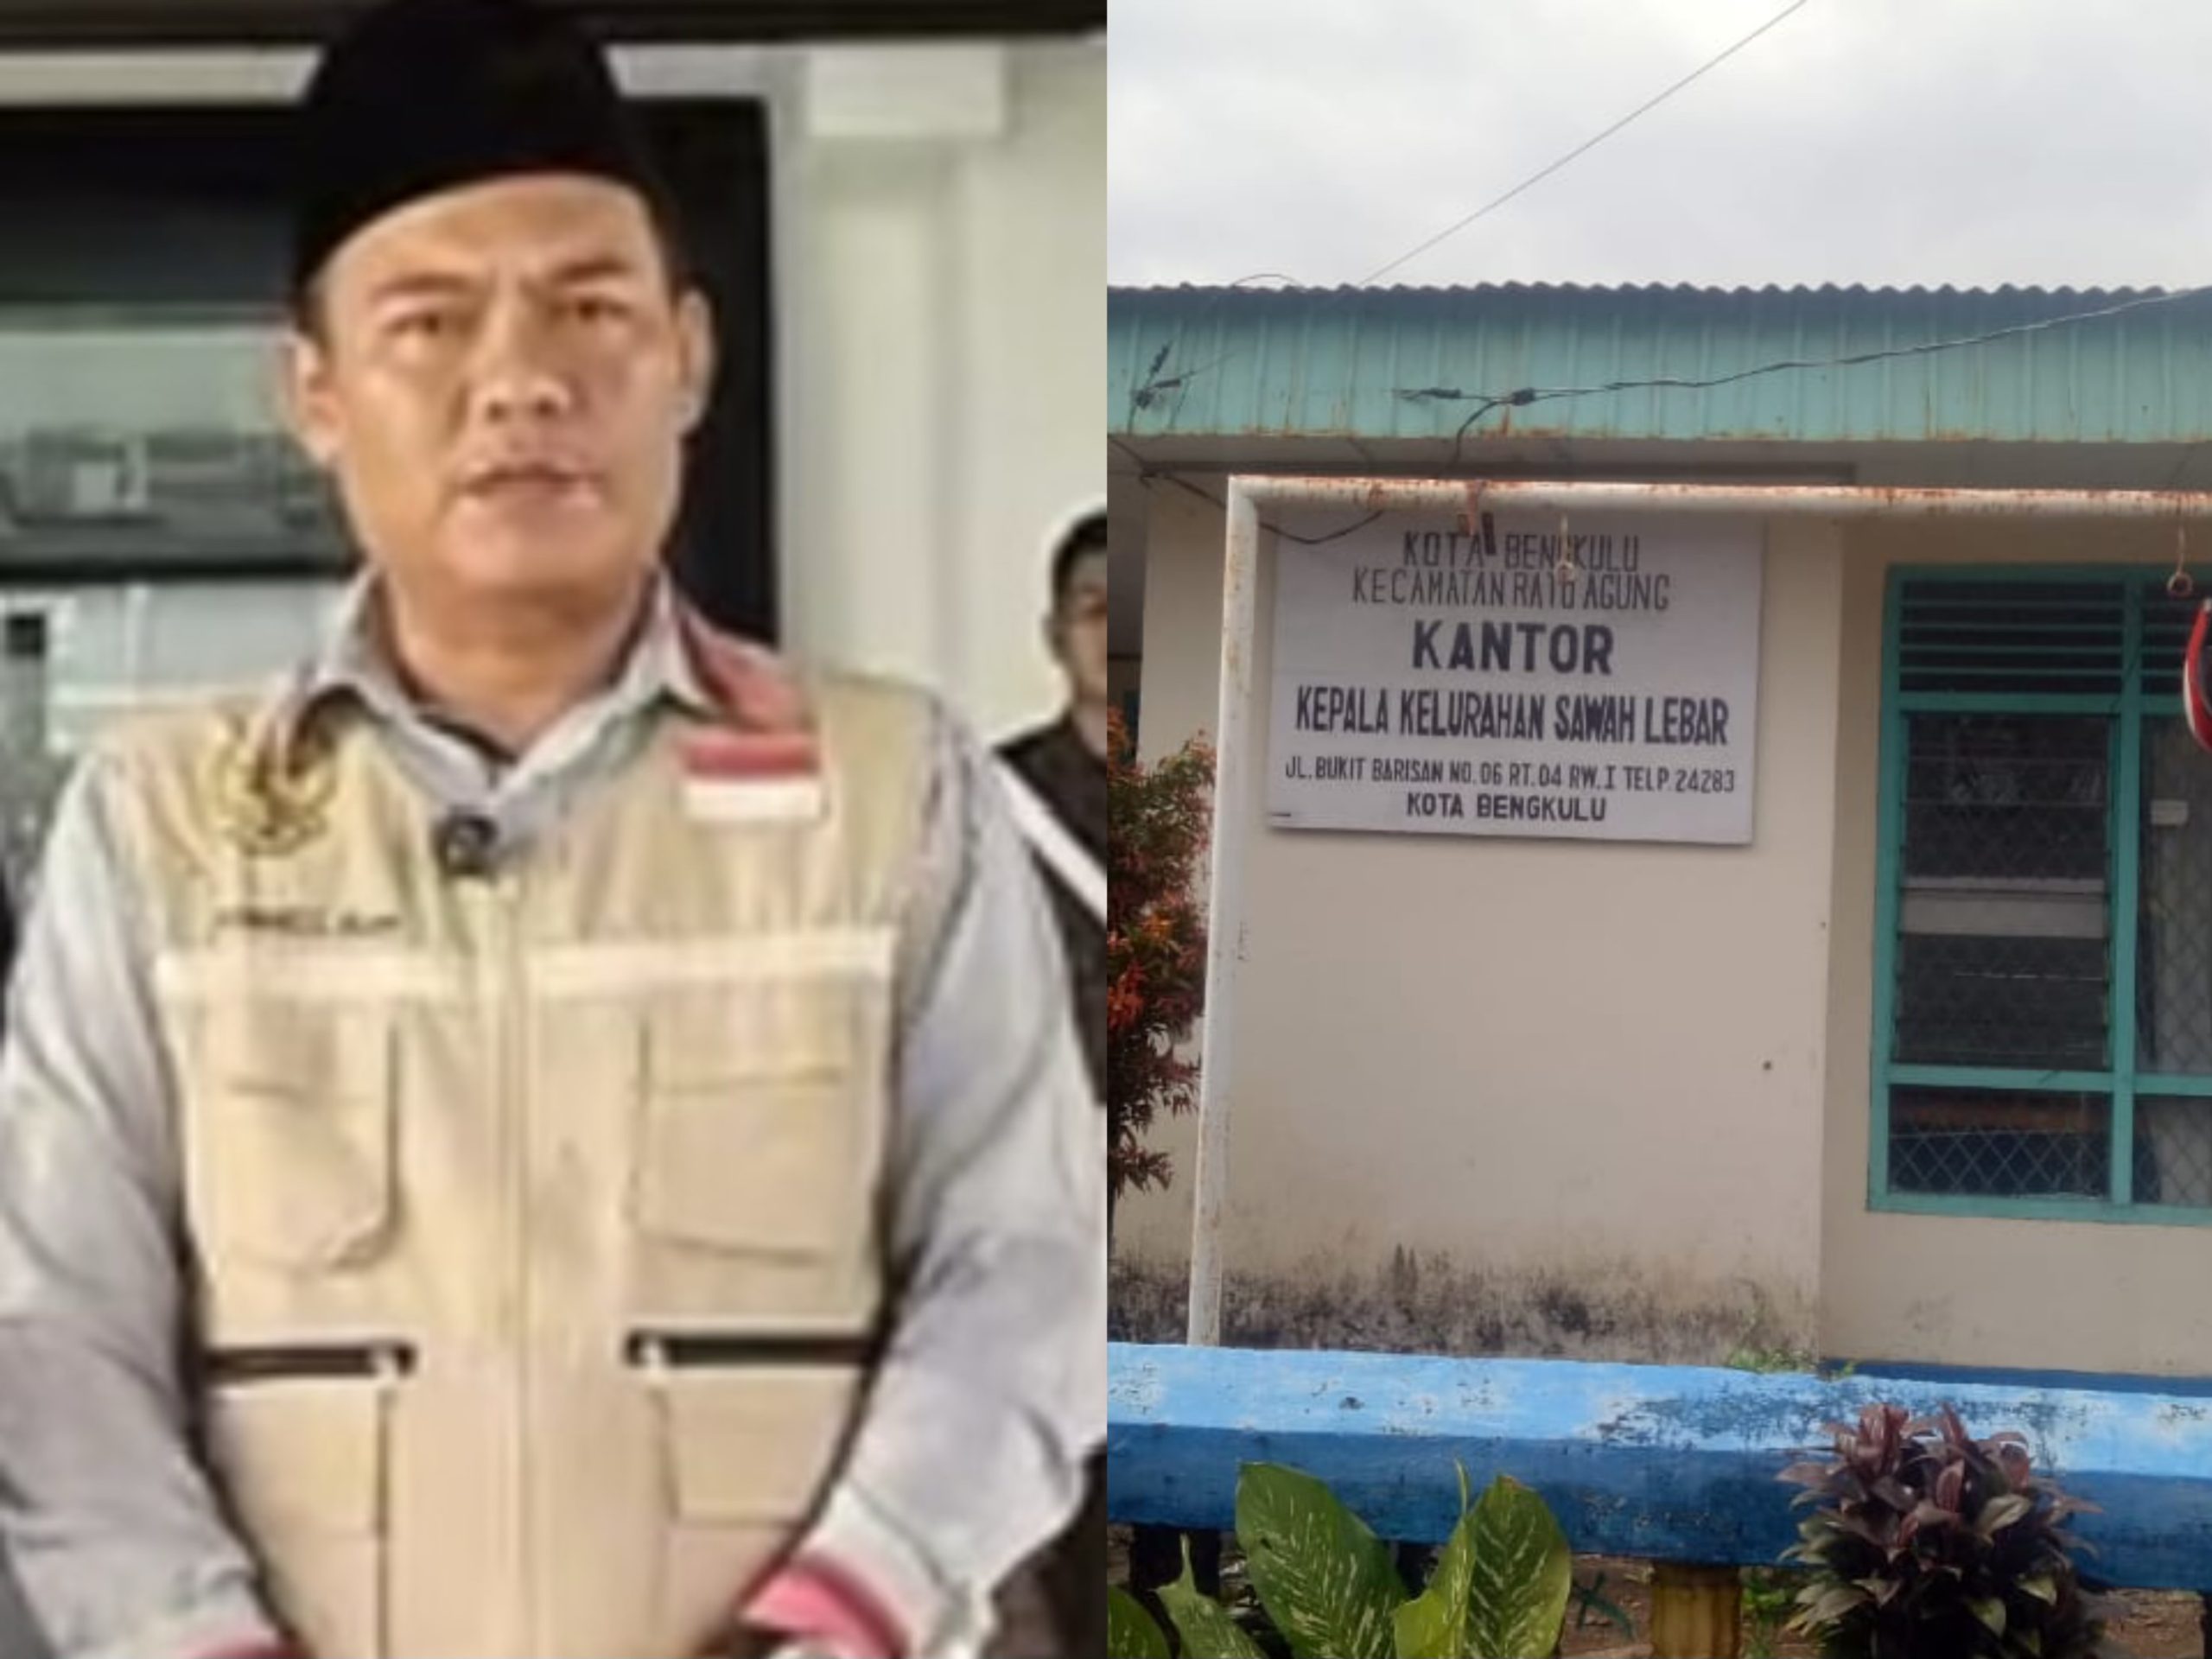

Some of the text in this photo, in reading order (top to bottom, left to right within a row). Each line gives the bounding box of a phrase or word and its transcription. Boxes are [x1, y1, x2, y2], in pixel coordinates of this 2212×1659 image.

[1403, 531, 1484, 567] KOTA
[1351, 568, 1505, 607] KECAMATAN
[1583, 573, 1671, 611] AGUNG
[1412, 620, 1614, 675] KANTOR
[1295, 685, 1728, 746] KEPALA KELURAHAN SAWAH LEBAR
[1371, 758, 1444, 784] BARISAN
[1407, 791, 1607, 823] KOTA BENGKULU
